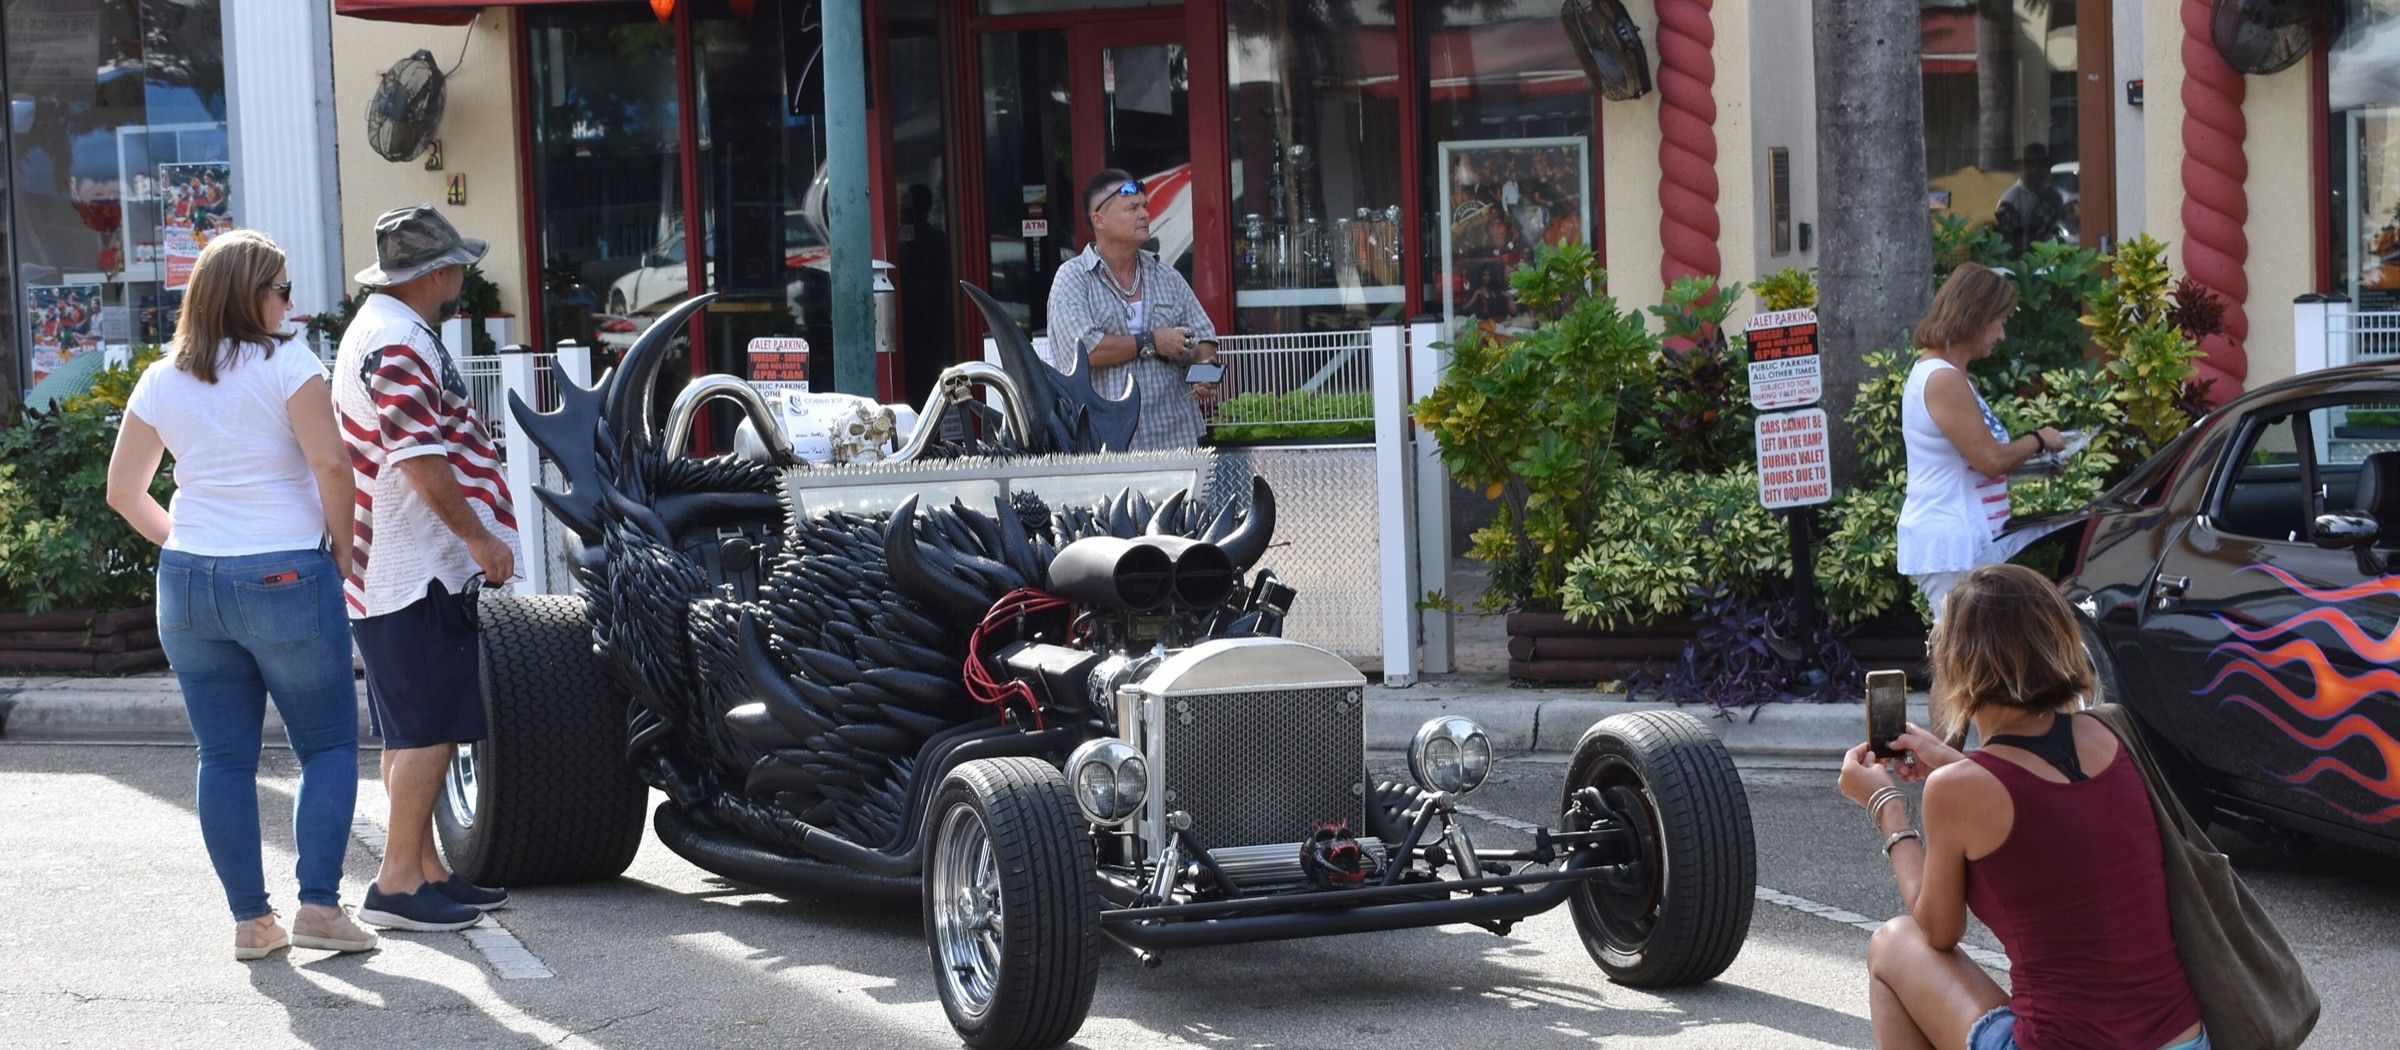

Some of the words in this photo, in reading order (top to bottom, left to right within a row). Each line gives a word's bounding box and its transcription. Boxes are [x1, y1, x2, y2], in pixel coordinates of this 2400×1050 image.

[448, 175, 463, 205] 4
[1025, 221, 1046, 230] ATM
[1747, 315, 1773, 328] VALET
[1775, 310, 1815, 325] PARKING
[1749, 328, 1784, 342] THURSDAY
[1789, 324, 1816, 337] SUNDAY
[750, 340, 772, 350] VALET
[774, 340, 808, 350] PARKING
[1757, 341, 1772, 349] AND
[1773, 336, 1810, 347] HOLIDAYS
[751, 353, 780, 363] THURSDAY
[784, 353, 807, 363] SUNDAY
[1754, 344, 1814, 360] 6PM-4AM
[1751, 362, 1778, 372] PUBLIC
[1780, 357, 1817, 370] PARKING
[753, 370, 804, 380] 6PM-4AM
[1753, 373, 1766, 381] ALL
[1768, 368, 1793, 379] OTHER
[1795, 366, 1817, 375] TIMES
[1760, 382, 1785, 392] SUBJECT
[1797, 380, 1811, 388] TOW
[1752, 391, 1777, 401] DURING
[1779, 389, 1797, 398] VALET
[1798, 387, 1819, 396] HOURS
[1761, 420, 1780, 435] CARS
[1782, 416, 1811, 432] CANNOT
[1813, 415, 1822, 428] BE
[1761, 438, 1776, 452] LEFT
[1778, 436, 1787, 450] ON
[1789, 435, 1801, 448] THE
[1803, 432, 1823, 447] RAMP
[1762, 452, 1797, 469] DURING
[1798, 449, 1824, 465] VALET
[1763, 470, 1794, 486] HOURS
[1796, 467, 1813, 482] DUE
[1814, 466, 1826, 480] TO
[1764, 488, 1782, 502] CITY
[1784, 483, 1828, 500] ORDINANCE
